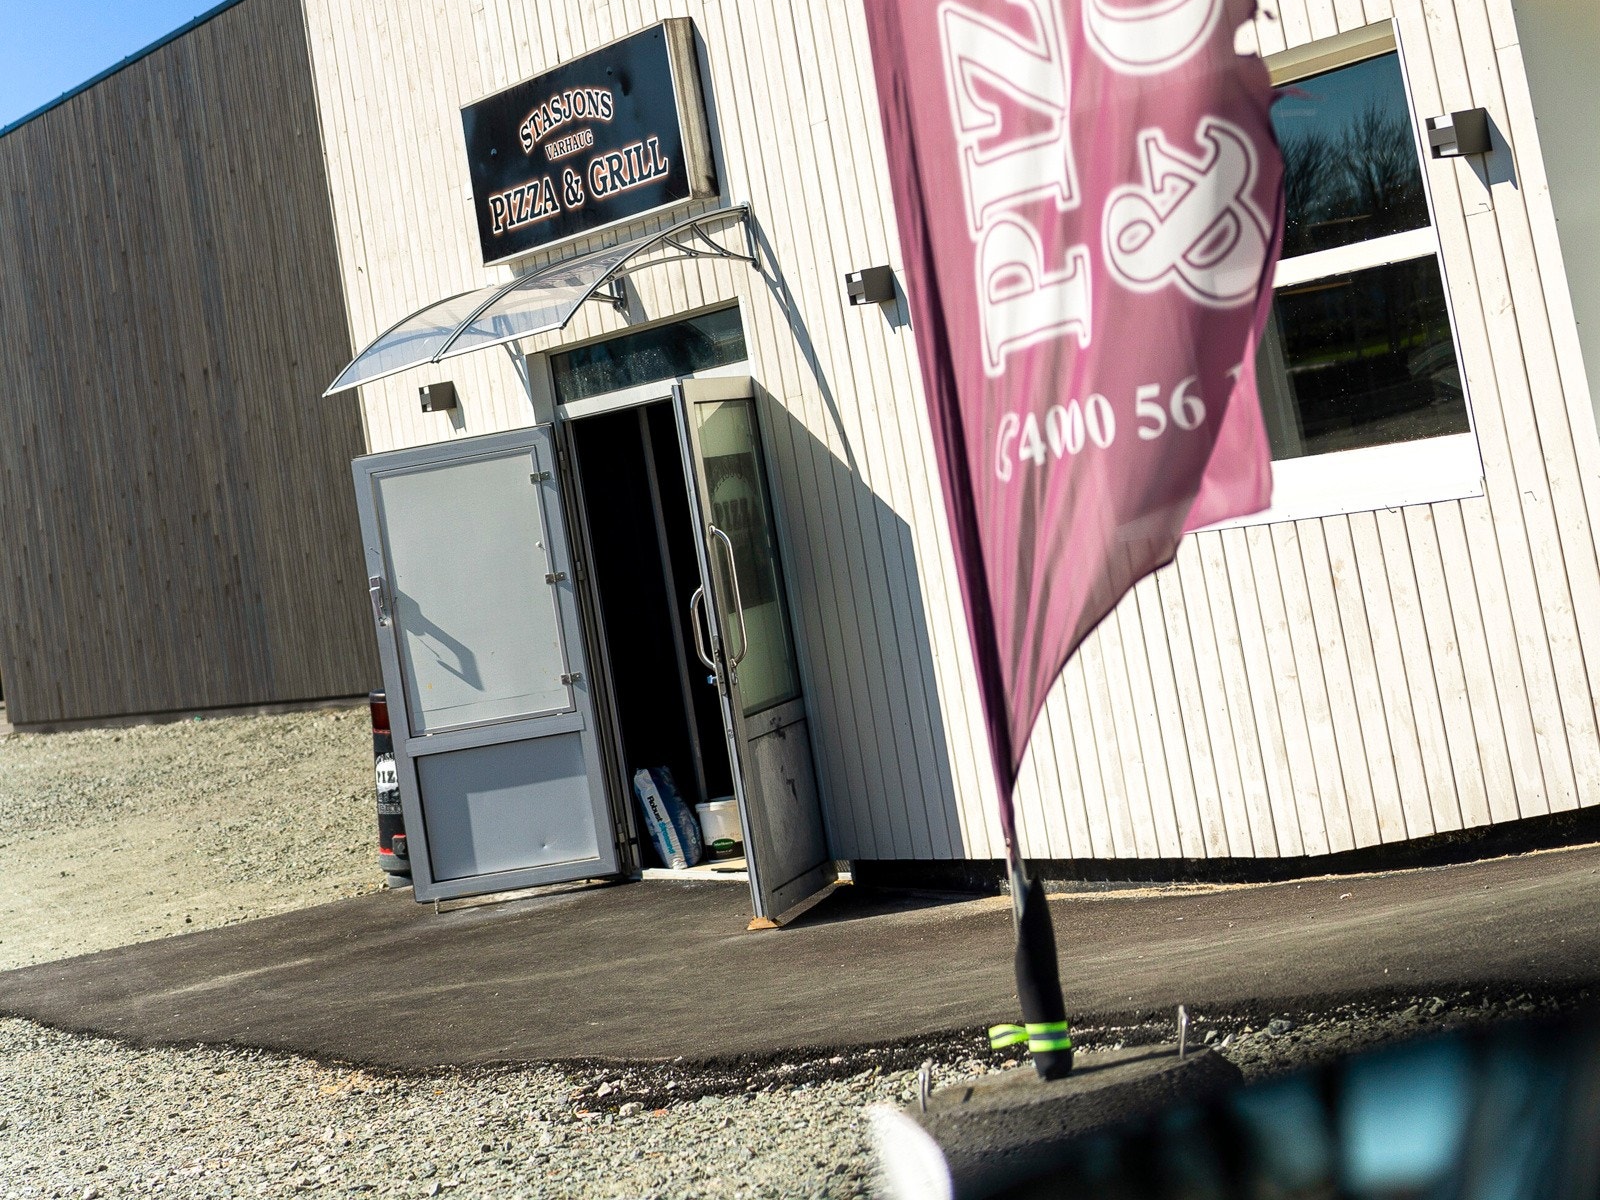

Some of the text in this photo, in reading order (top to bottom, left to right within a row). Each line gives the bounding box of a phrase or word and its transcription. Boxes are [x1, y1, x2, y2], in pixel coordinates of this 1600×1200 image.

[520, 88, 613, 152] STASJONS
[545, 129, 594, 161] VARHAUG
[489, 136, 669, 234] PIZZA & GRILL
[1099, 115, 1275, 310] &
[1136, 374, 1206, 440] 56
[647, 795, 663, 822] Robust
